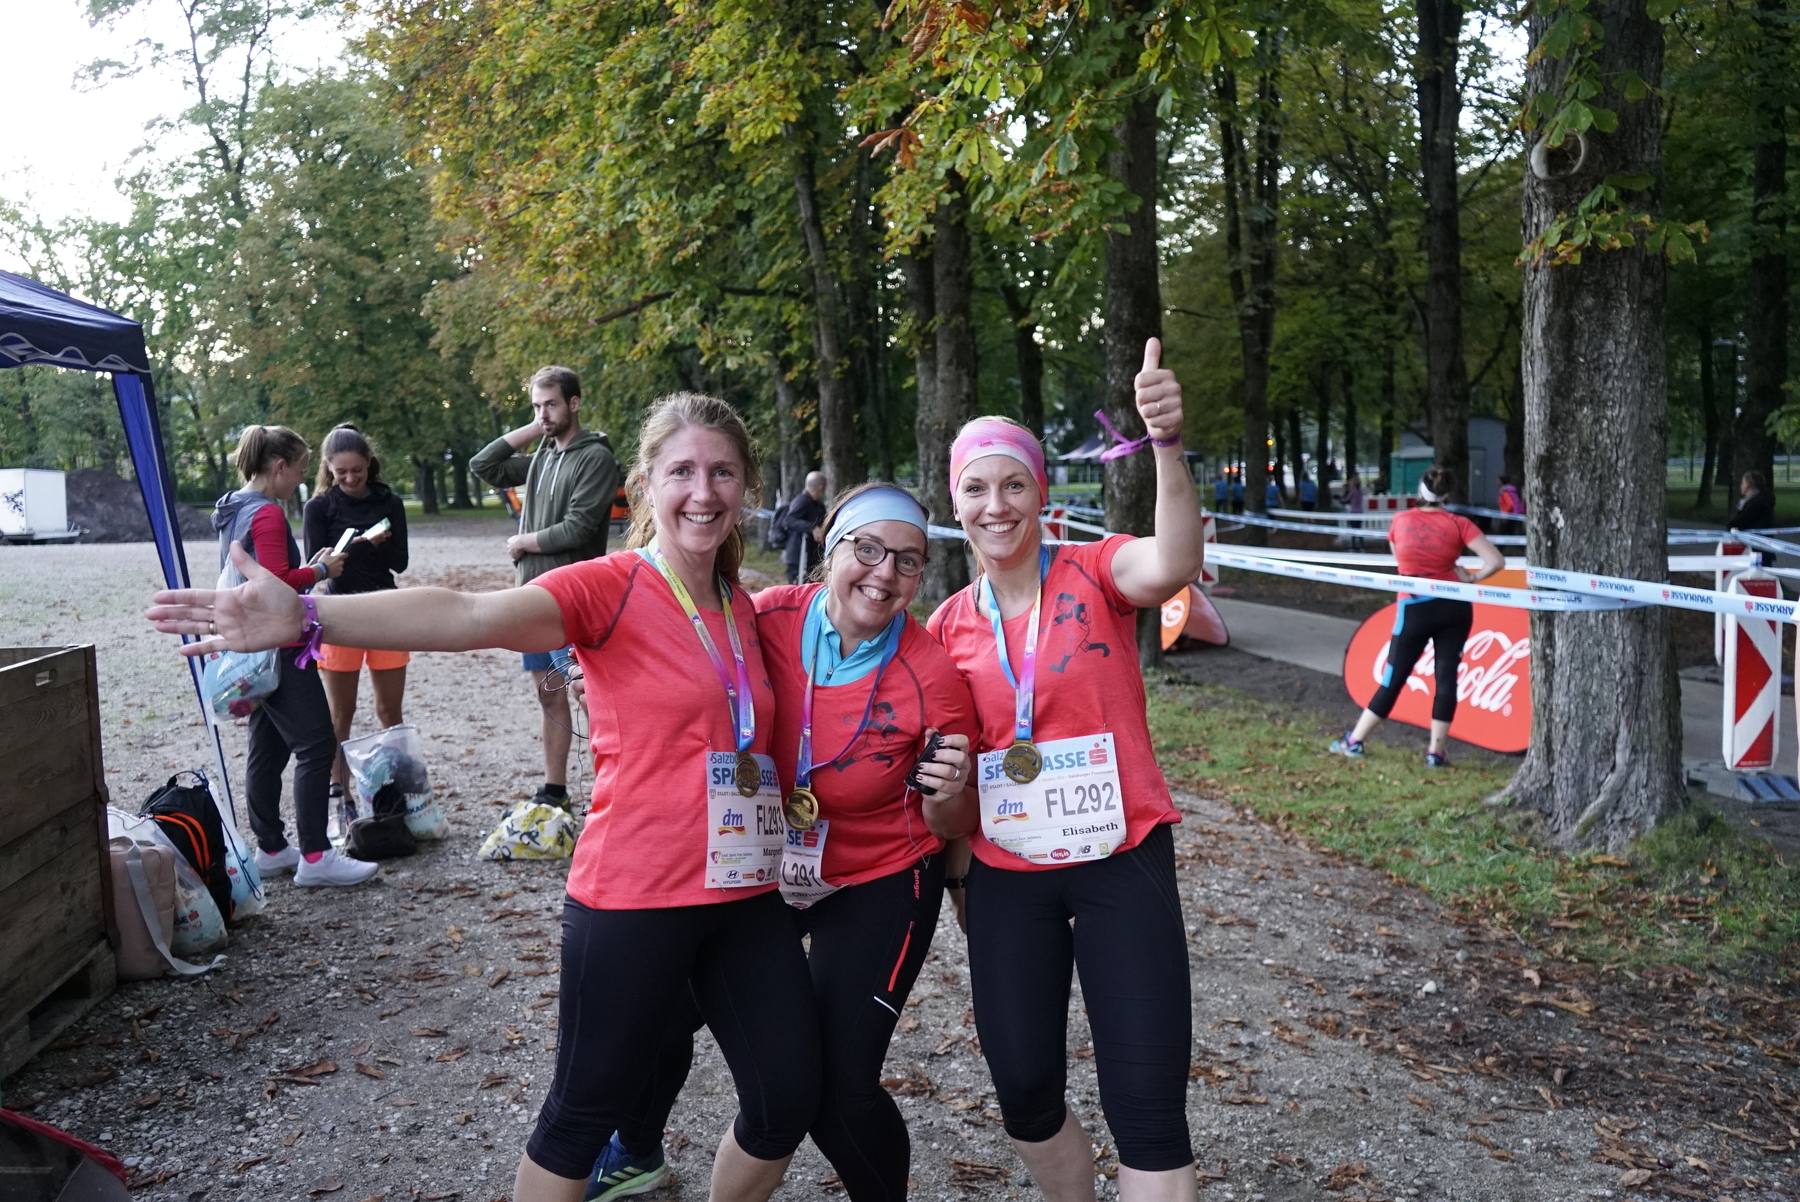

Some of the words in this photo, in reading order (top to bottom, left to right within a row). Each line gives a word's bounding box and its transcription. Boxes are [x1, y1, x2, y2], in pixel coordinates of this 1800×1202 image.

[1598, 581, 1635, 593] SPARKASSE
[1670, 590, 1714, 604] SPARKASSE
[1754, 602, 1794, 615] ARKASSE
[997, 799, 1024, 816] dm
[1045, 781, 1117, 818] FL292
[722, 808, 743, 826] dm
[756, 805, 784, 835] FL293
[1062, 822, 1119, 837] Elisabeth
